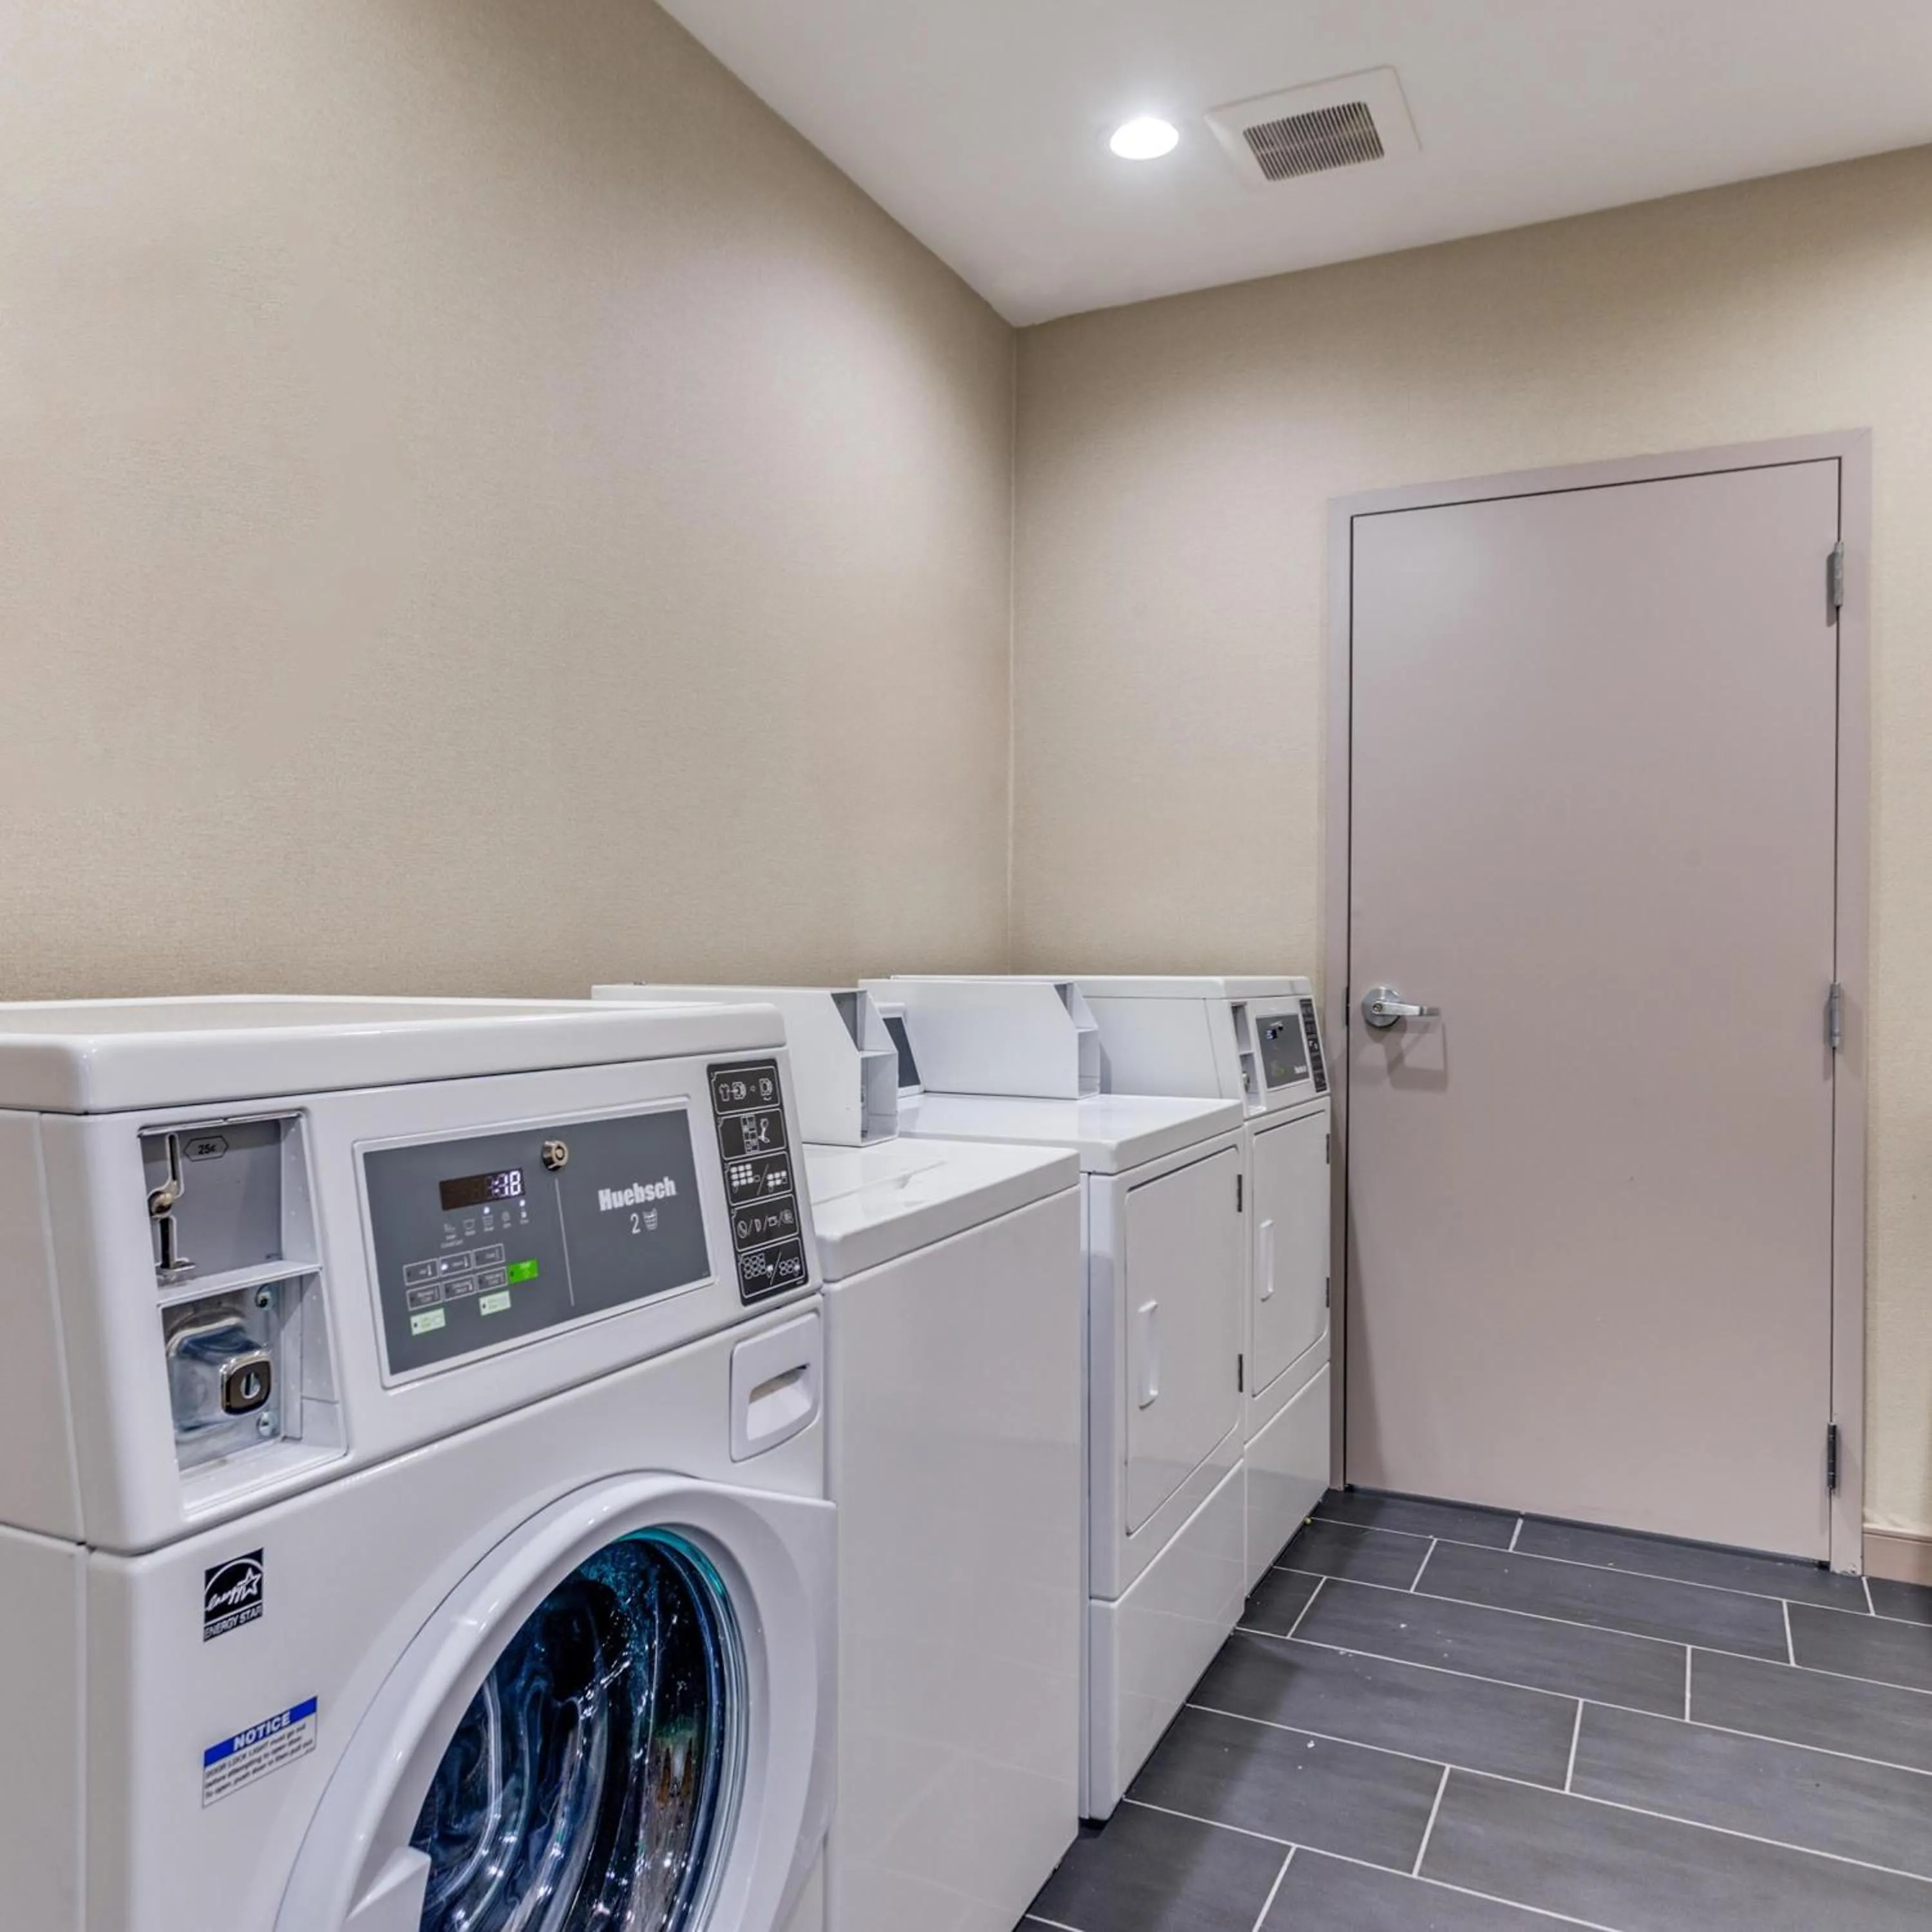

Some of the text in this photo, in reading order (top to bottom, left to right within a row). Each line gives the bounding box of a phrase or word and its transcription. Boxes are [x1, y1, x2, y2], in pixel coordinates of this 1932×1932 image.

[598, 1175, 677, 1211] Huebsch
[630, 1213, 641, 1234] 2
[233, 1710, 291, 1752] NOTICE
